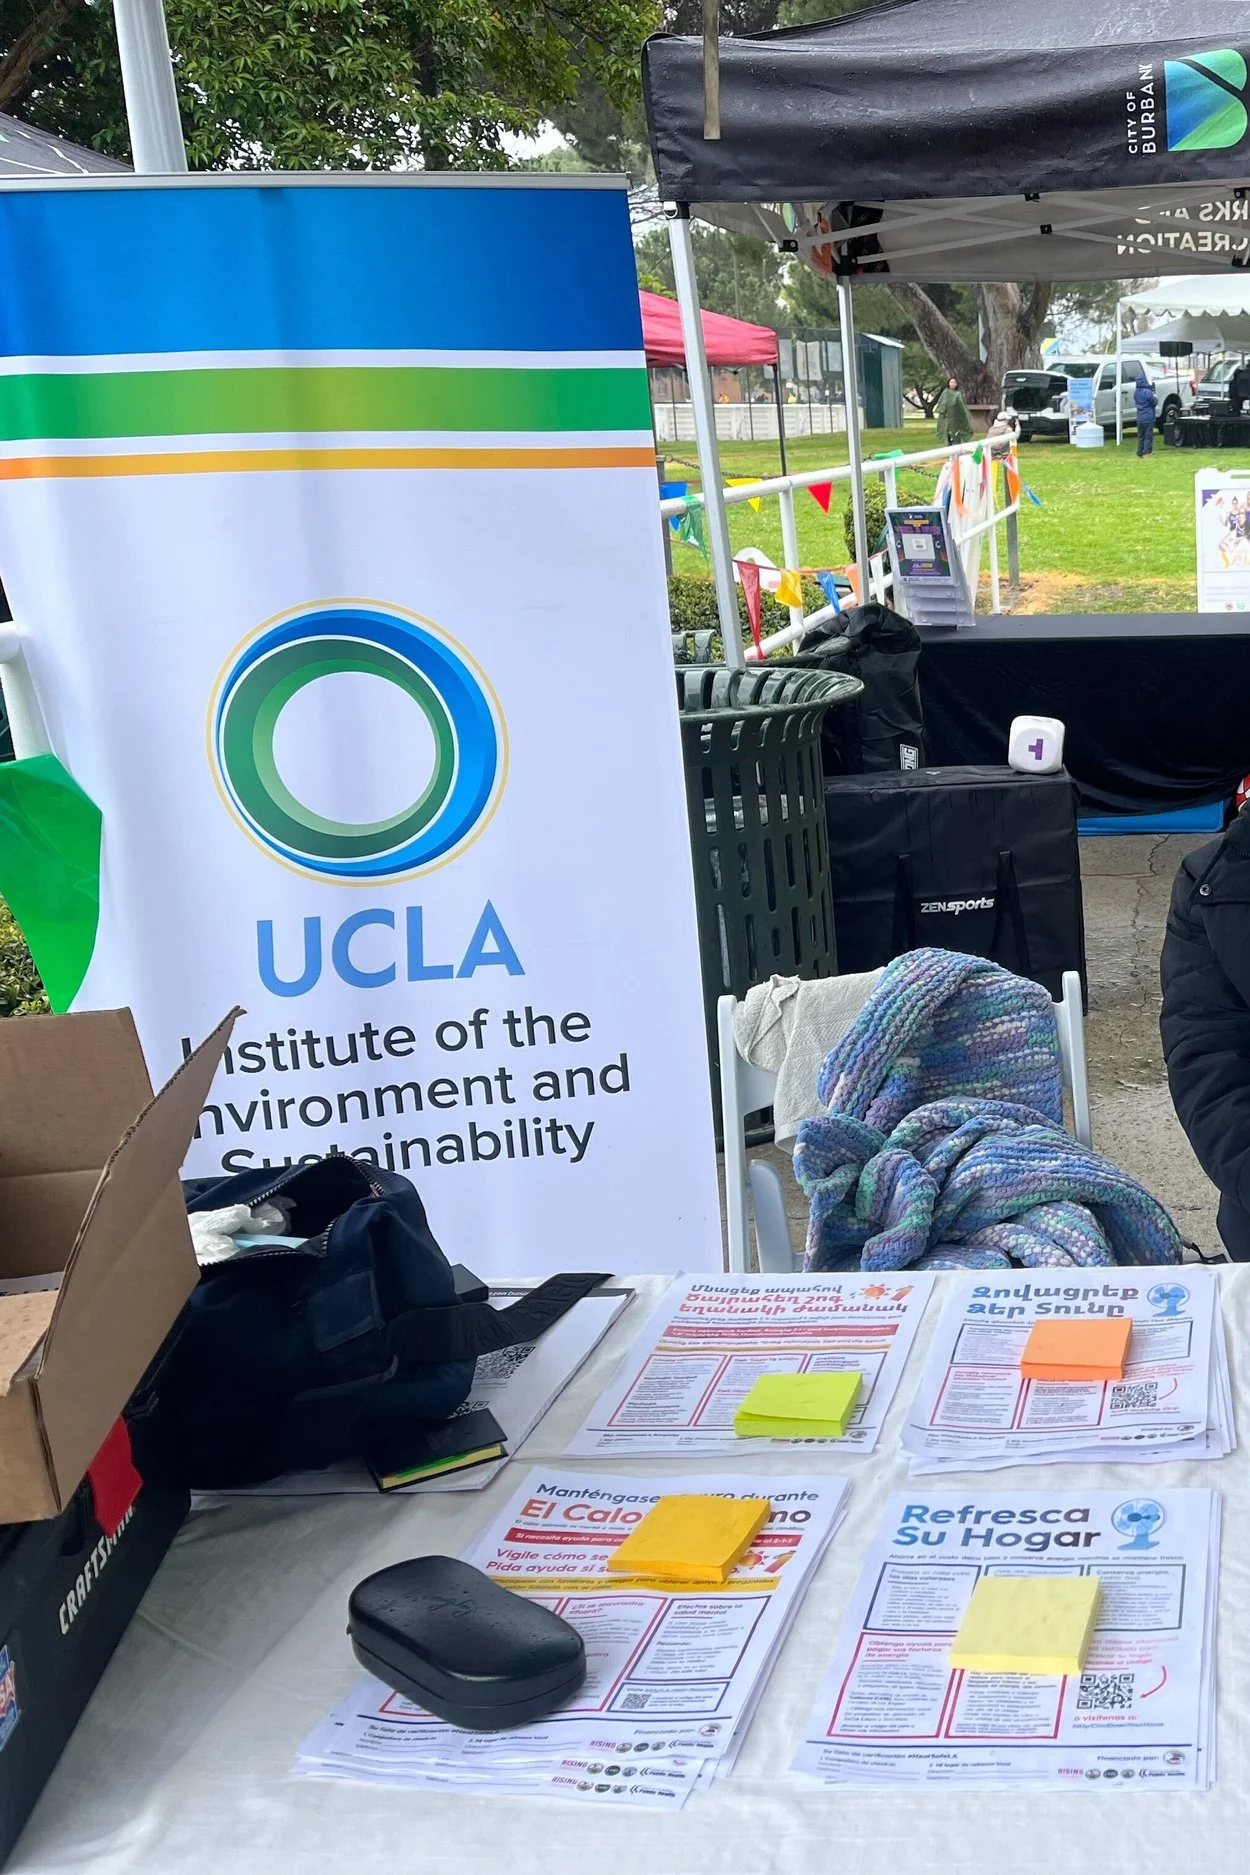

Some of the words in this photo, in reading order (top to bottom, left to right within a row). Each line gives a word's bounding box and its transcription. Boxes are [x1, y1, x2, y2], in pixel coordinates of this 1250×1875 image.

[1127, 91, 1137, 111] OF
[1141, 63, 1156, 154] BURBANK
[1128, 114, 1138, 155] CITY
[920, 897, 995, 915] ZENsports
[256, 898, 526, 998] UCLA
[436, 1011, 488, 1051] of
[508, 1005, 592, 1047] the
[194, 1069, 515, 1140] nvironment
[533, 1053, 631, 1101] and
[536, 1483, 662, 1505] Manténgase
[741, 1490, 820, 1502] durante
[520, 1498, 556, 1520] El
[563, 1503, 649, 1525] Calo
[900, 1504, 1090, 1525] Refresca
[525, 1533, 562, 1542] necesita
[563, 1535, 591, 1544] ayuda
[592, 1536, 612, 1545] para
[773, 1537, 794, 1545] 2-1-1
[892, 1525, 947, 1547] Su
[960, 1527, 1102, 1553] Hogar
[496, 1547, 540, 1566] Vigile
[543, 1549, 586, 1562] cómo
[590, 1552, 608, 1562] se
[485, 1559, 519, 1574] Pida
[524, 1561, 578, 1575] ayuda
[581, 1563, 596, 1573] si
[866, 1647, 892, 1655] pagar
[868, 1640, 905, 1648] Obtenga
[906, 1641, 933, 1649] ayuda
[634, 1728, 675, 1736] Financiado
[589, 1739, 616, 1749] RISING
[561, 1759, 588, 1769] RISING
[1057, 1767, 1084, 1775] RISING
[551, 1776, 578, 1786] RISING
